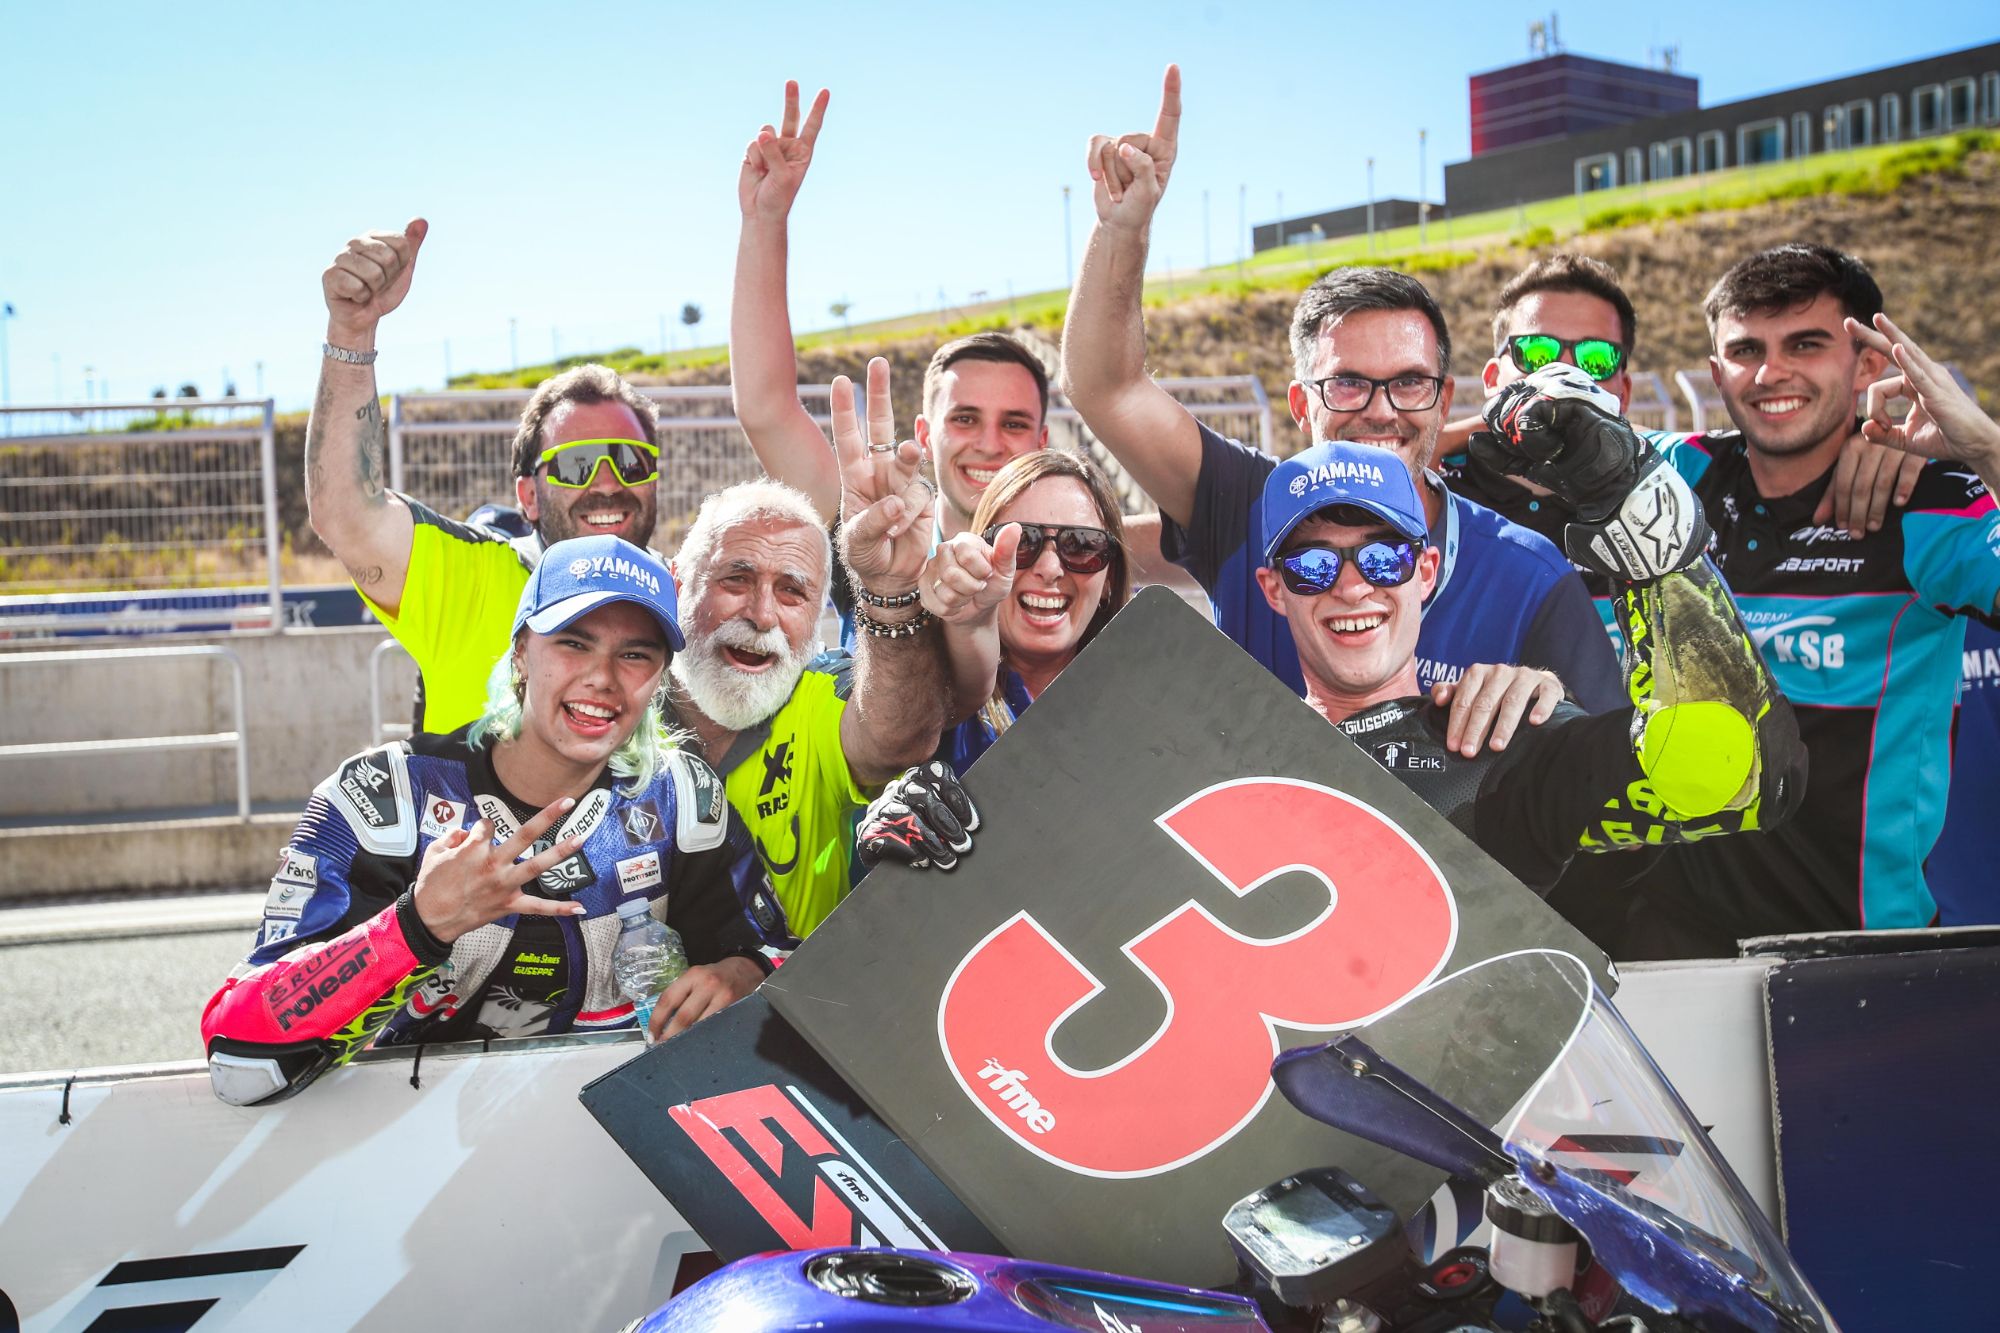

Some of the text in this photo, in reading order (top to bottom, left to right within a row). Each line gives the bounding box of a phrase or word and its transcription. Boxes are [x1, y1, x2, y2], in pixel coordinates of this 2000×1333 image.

[1297, 477, 1379, 498] RACING
[1307, 462, 1384, 485] YAMAHA
[577, 572, 656, 596] RACING
[592, 557, 660, 593] YAMAHA
[1774, 630, 1844, 671] KSB
[1408, 756, 1440, 769] Erik
[287, 861, 314, 880] Faro
[277, 946, 374, 1031] rolear
[938, 776, 1460, 1179] 3
[977, 1058, 1056, 1134] rfme
[837, 1170, 870, 1204] rfme
